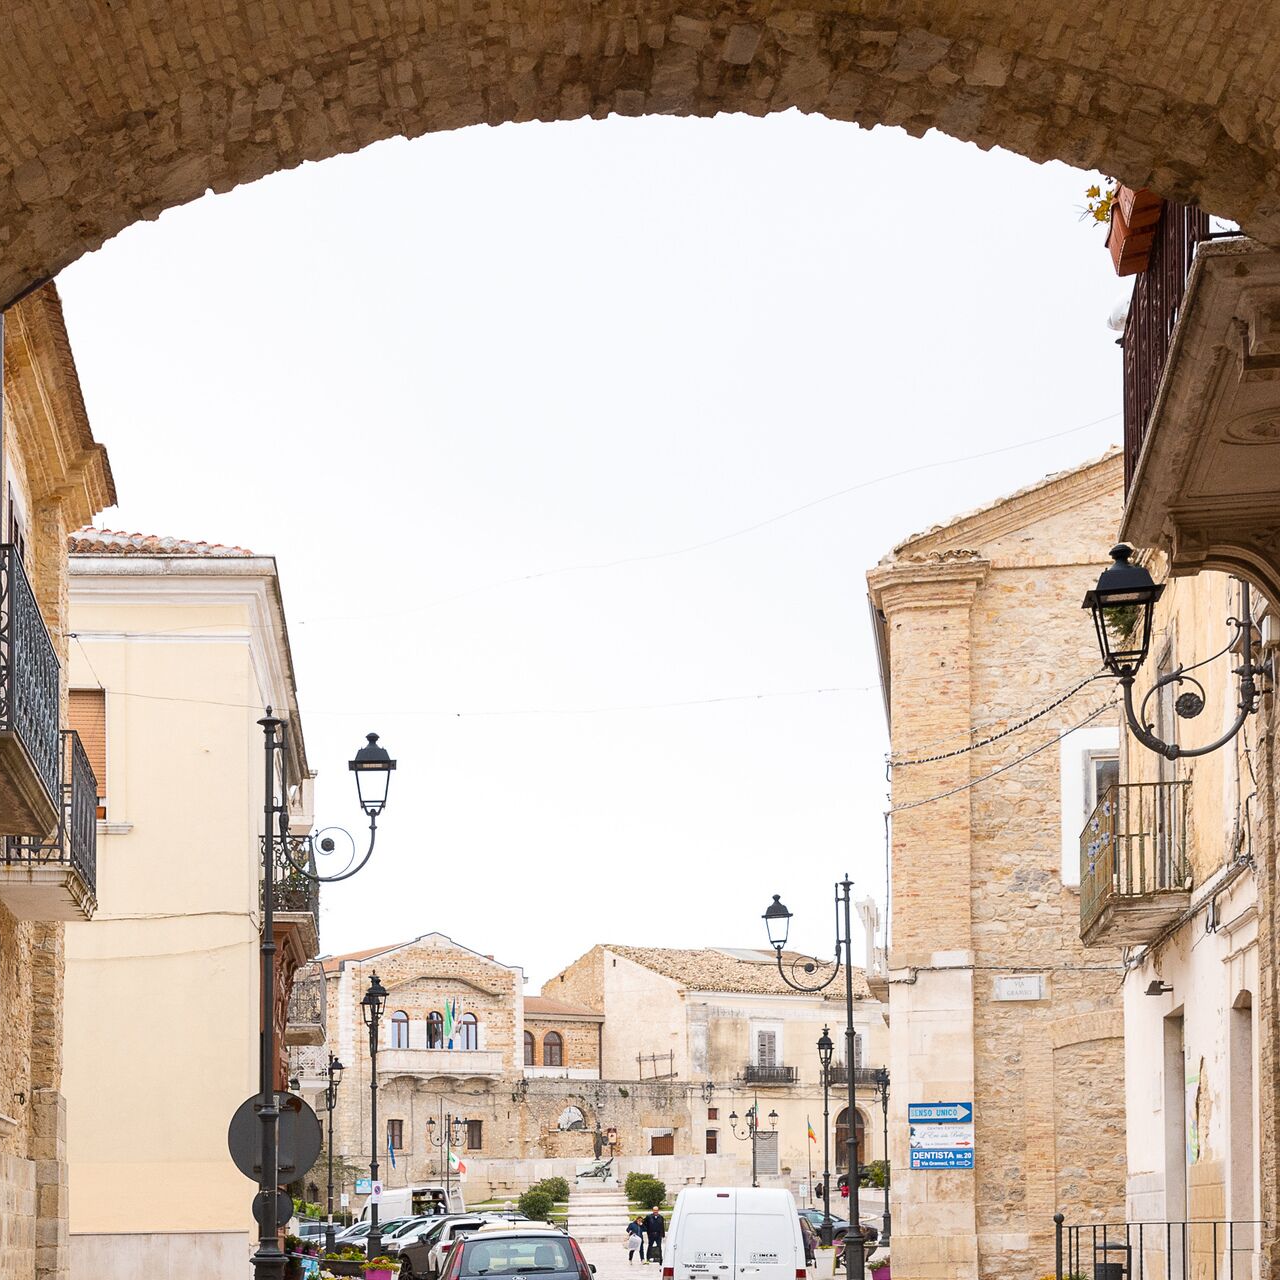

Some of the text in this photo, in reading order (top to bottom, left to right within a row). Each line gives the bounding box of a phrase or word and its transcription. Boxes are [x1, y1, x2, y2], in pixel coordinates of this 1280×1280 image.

[910, 1108, 958, 1117] SENSO UNICO
[912, 1151, 954, 1160] DENTISTA
